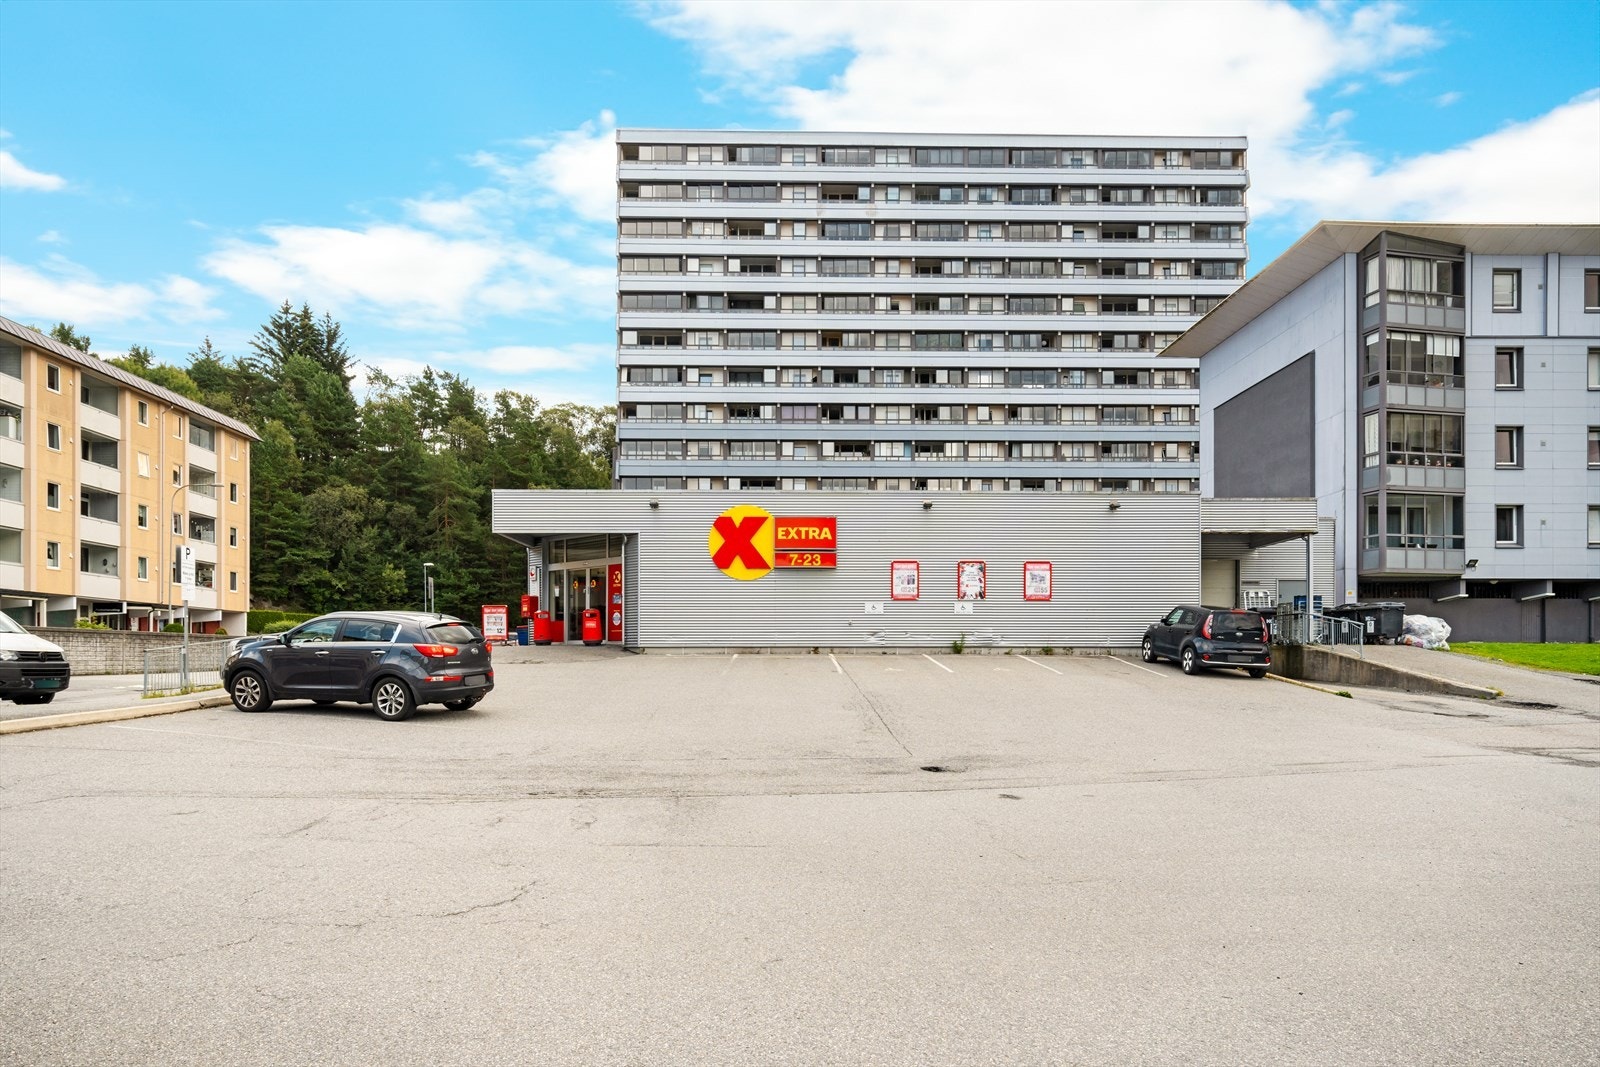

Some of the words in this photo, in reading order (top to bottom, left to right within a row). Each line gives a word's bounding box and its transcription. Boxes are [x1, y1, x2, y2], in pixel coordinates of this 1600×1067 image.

[777, 527, 832, 540] EXTRA
[711, 516, 772, 569] X
[185, 547, 191, 560] P
[789, 554, 822, 566] 7-23
